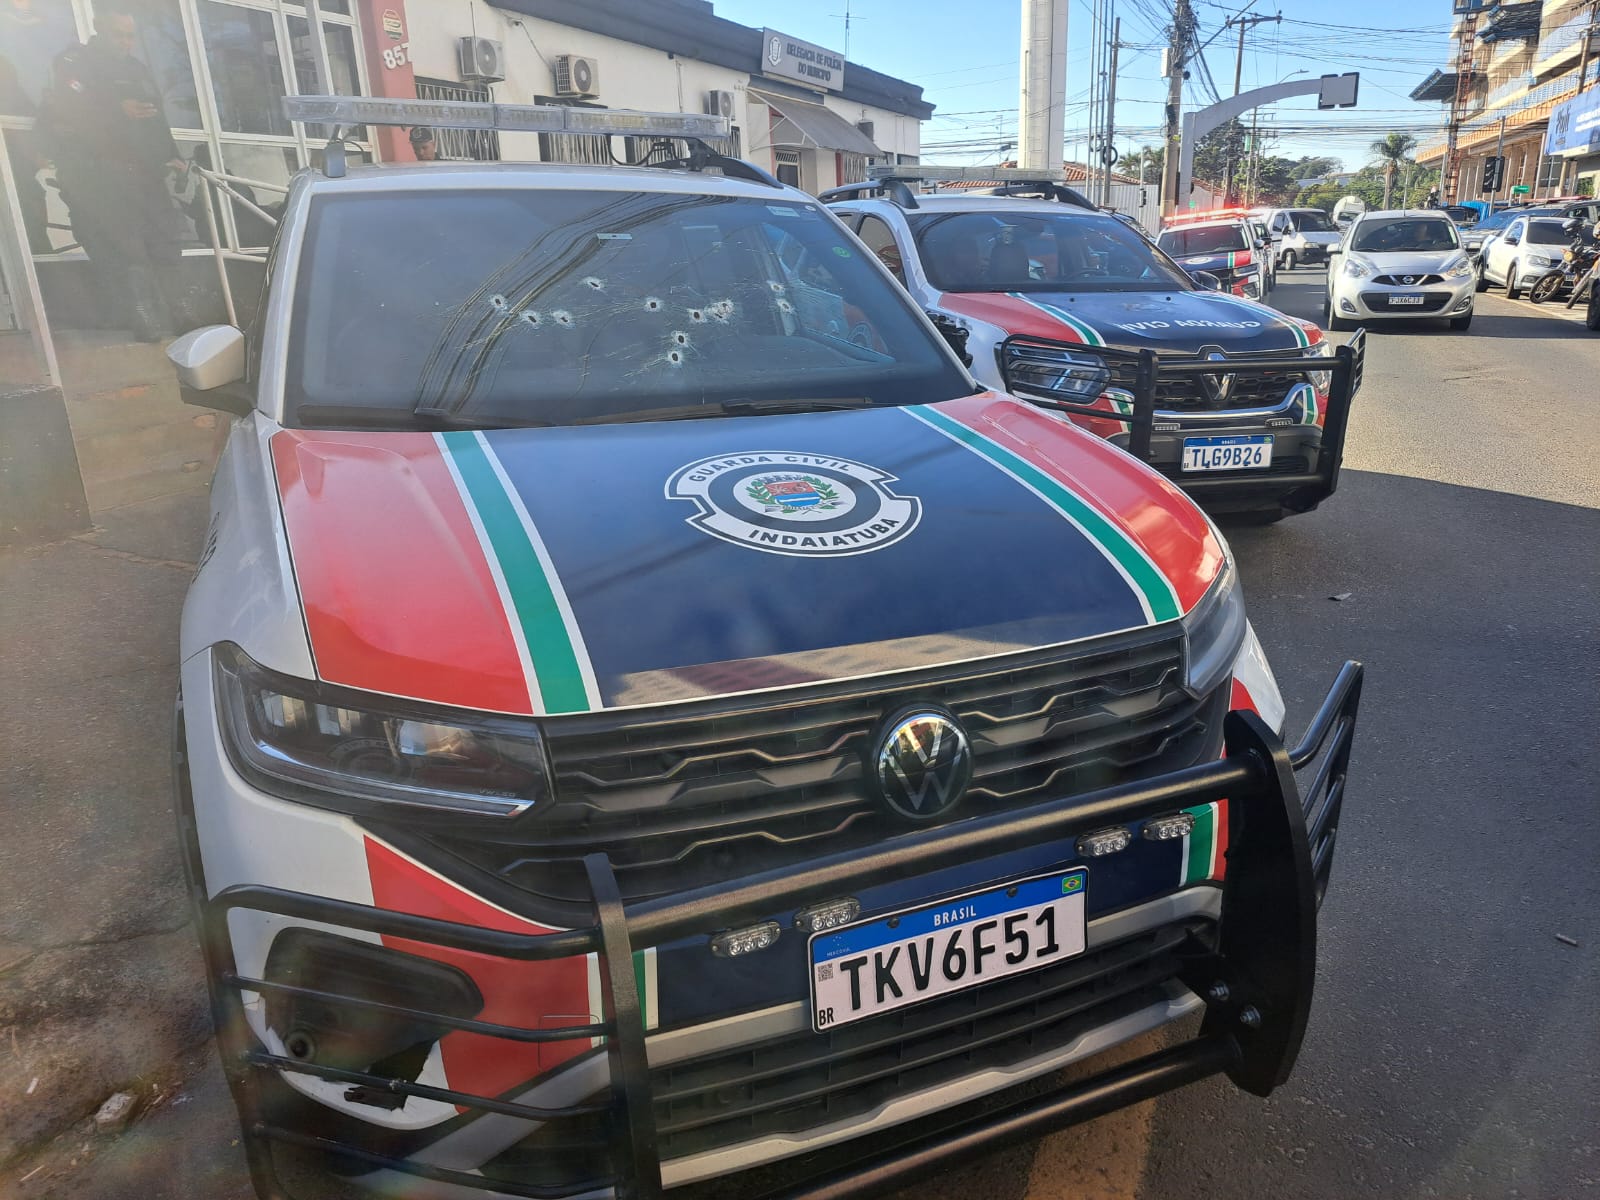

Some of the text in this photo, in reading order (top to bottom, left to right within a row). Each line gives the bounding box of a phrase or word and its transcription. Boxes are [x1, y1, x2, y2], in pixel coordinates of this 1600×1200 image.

[383, 42, 412, 69] 857
[786, 43, 815, 61] DELEGACIA
[816, 52, 824, 65] DE
[798, 61, 806, 74] DO
[1192, 447, 1262, 467] TLG9B26
[688, 456, 851, 483] GUARDA CIVIL
[748, 518, 900, 547] INDAIATUBA
[934, 905, 977, 926] BRASIL
[840, 905, 1059, 1011] TKV6F51
[819, 1006, 835, 1026] BR
